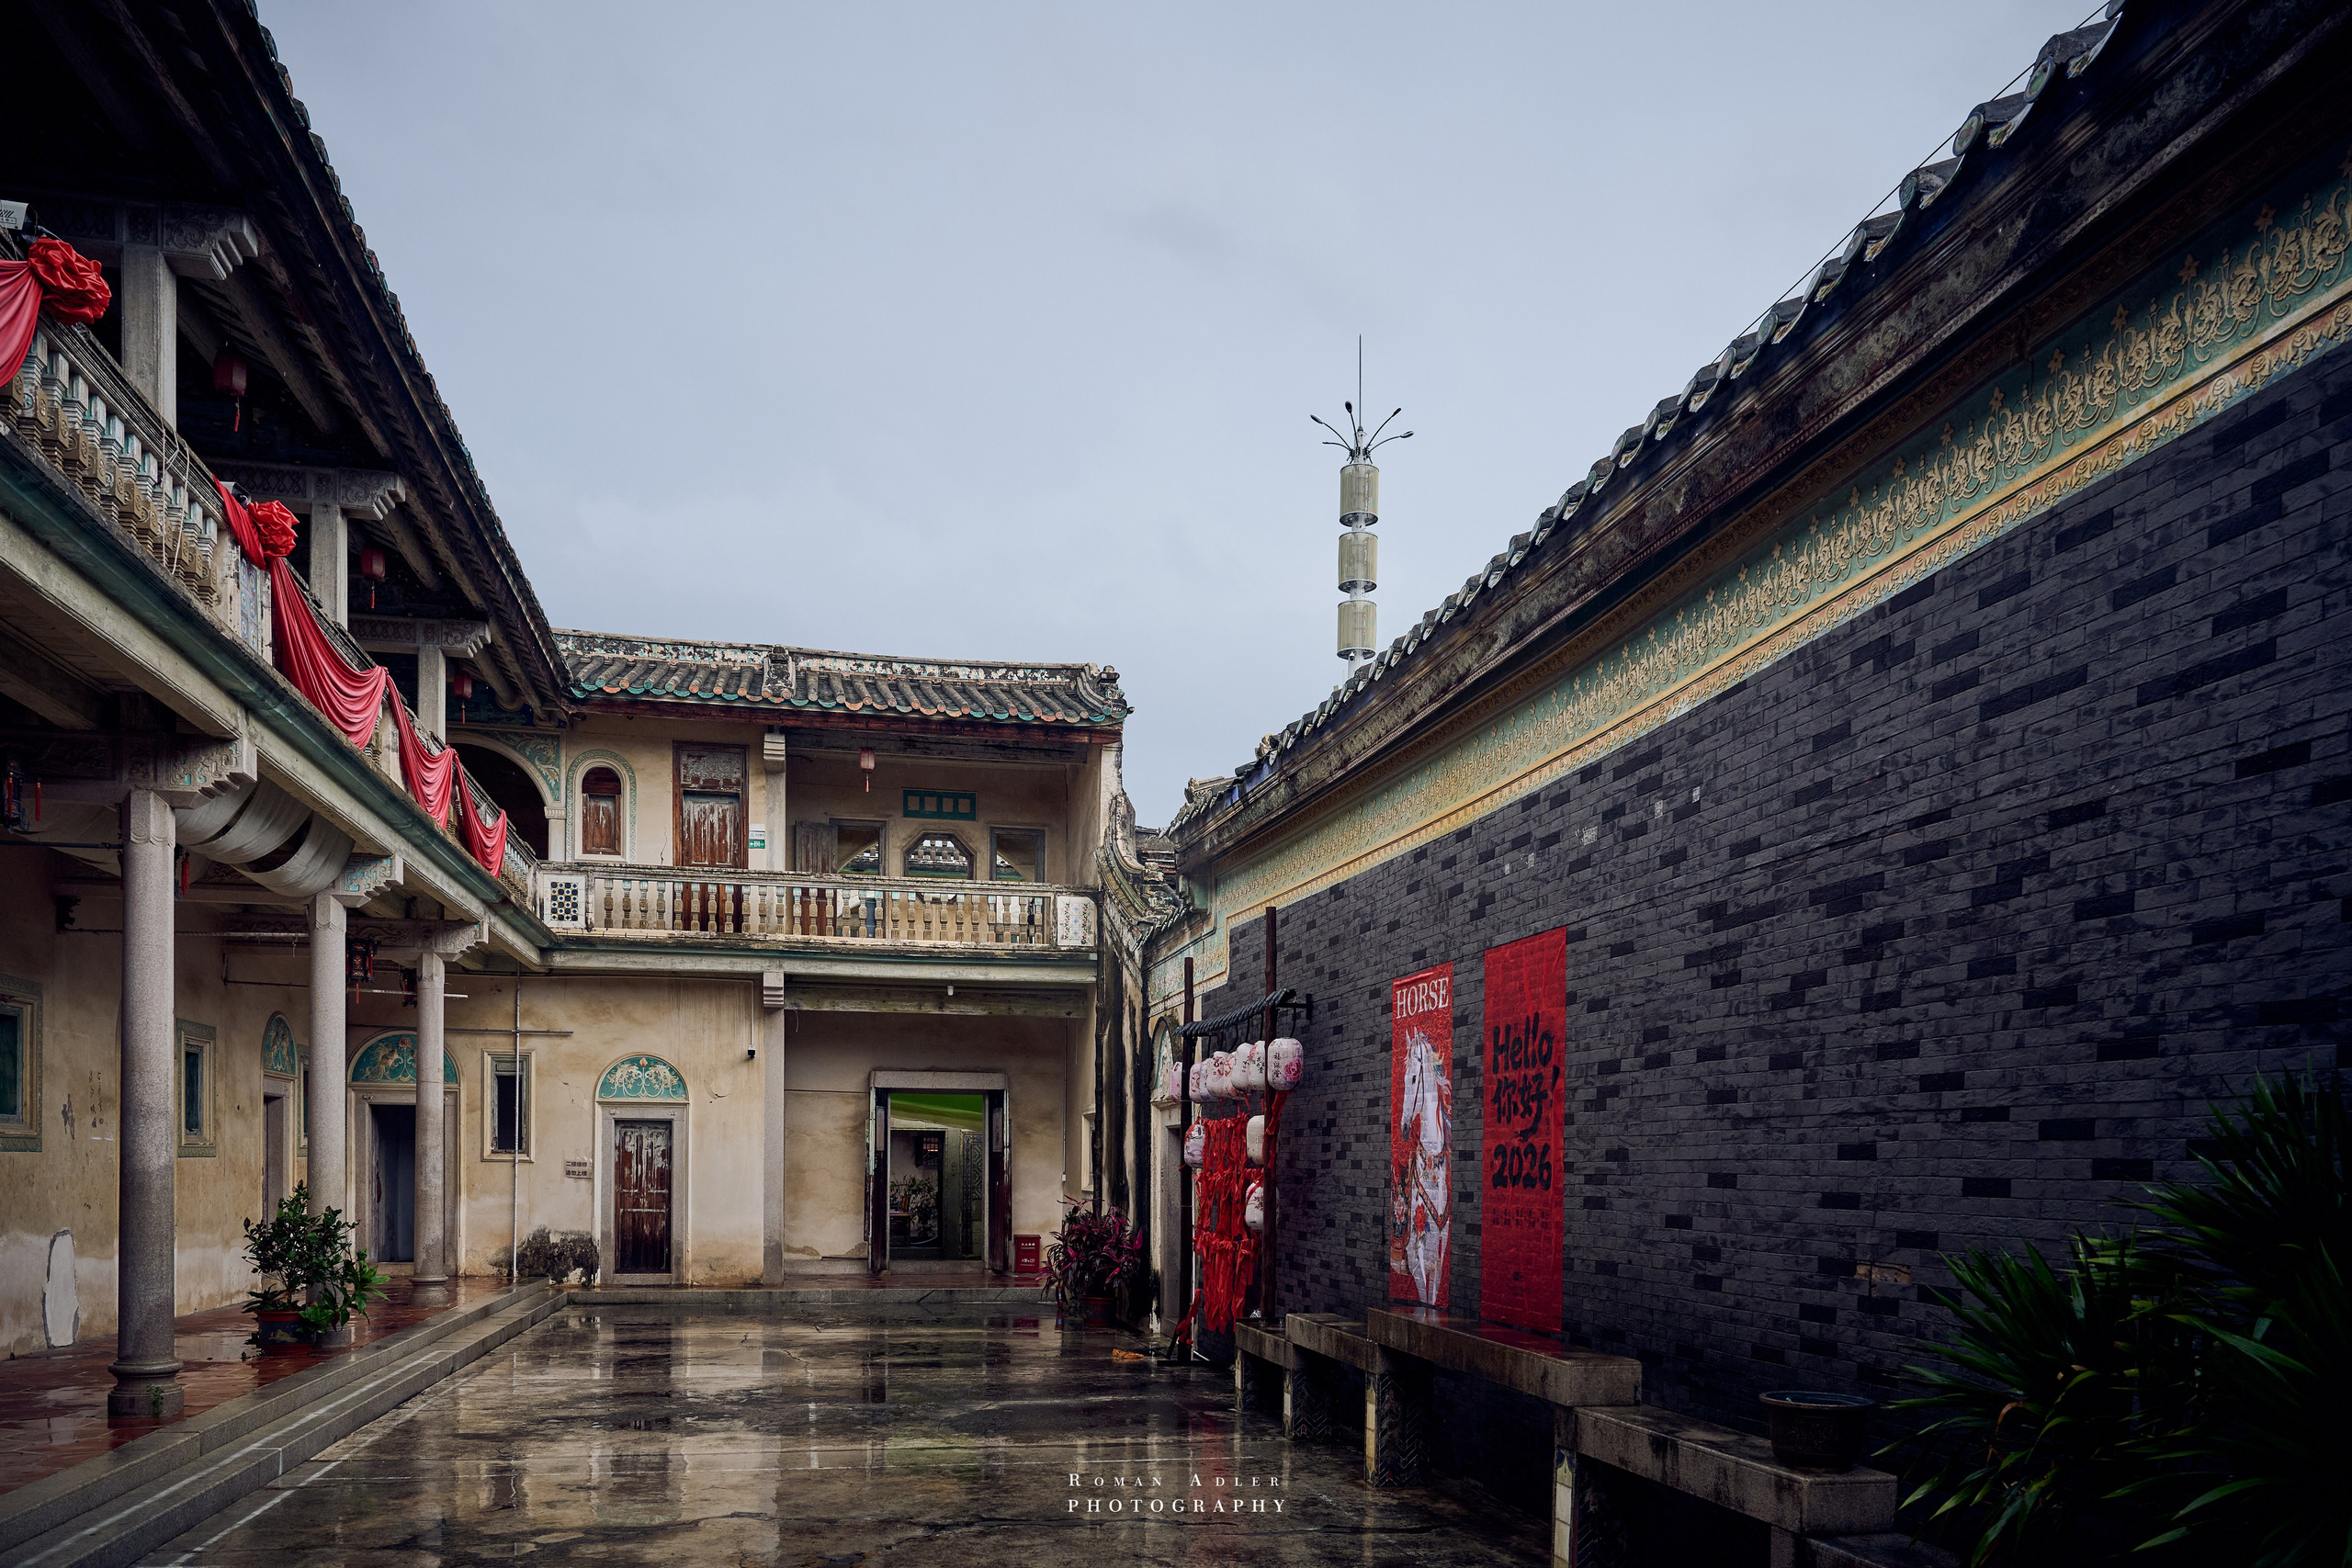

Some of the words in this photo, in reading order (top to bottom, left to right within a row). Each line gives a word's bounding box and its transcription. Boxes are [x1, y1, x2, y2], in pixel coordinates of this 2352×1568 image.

[1395, 977, 1450, 1019] HORSE
[1492, 1011, 1555, 1074] Hello
[1492, 1144, 1552, 1190] 2026
